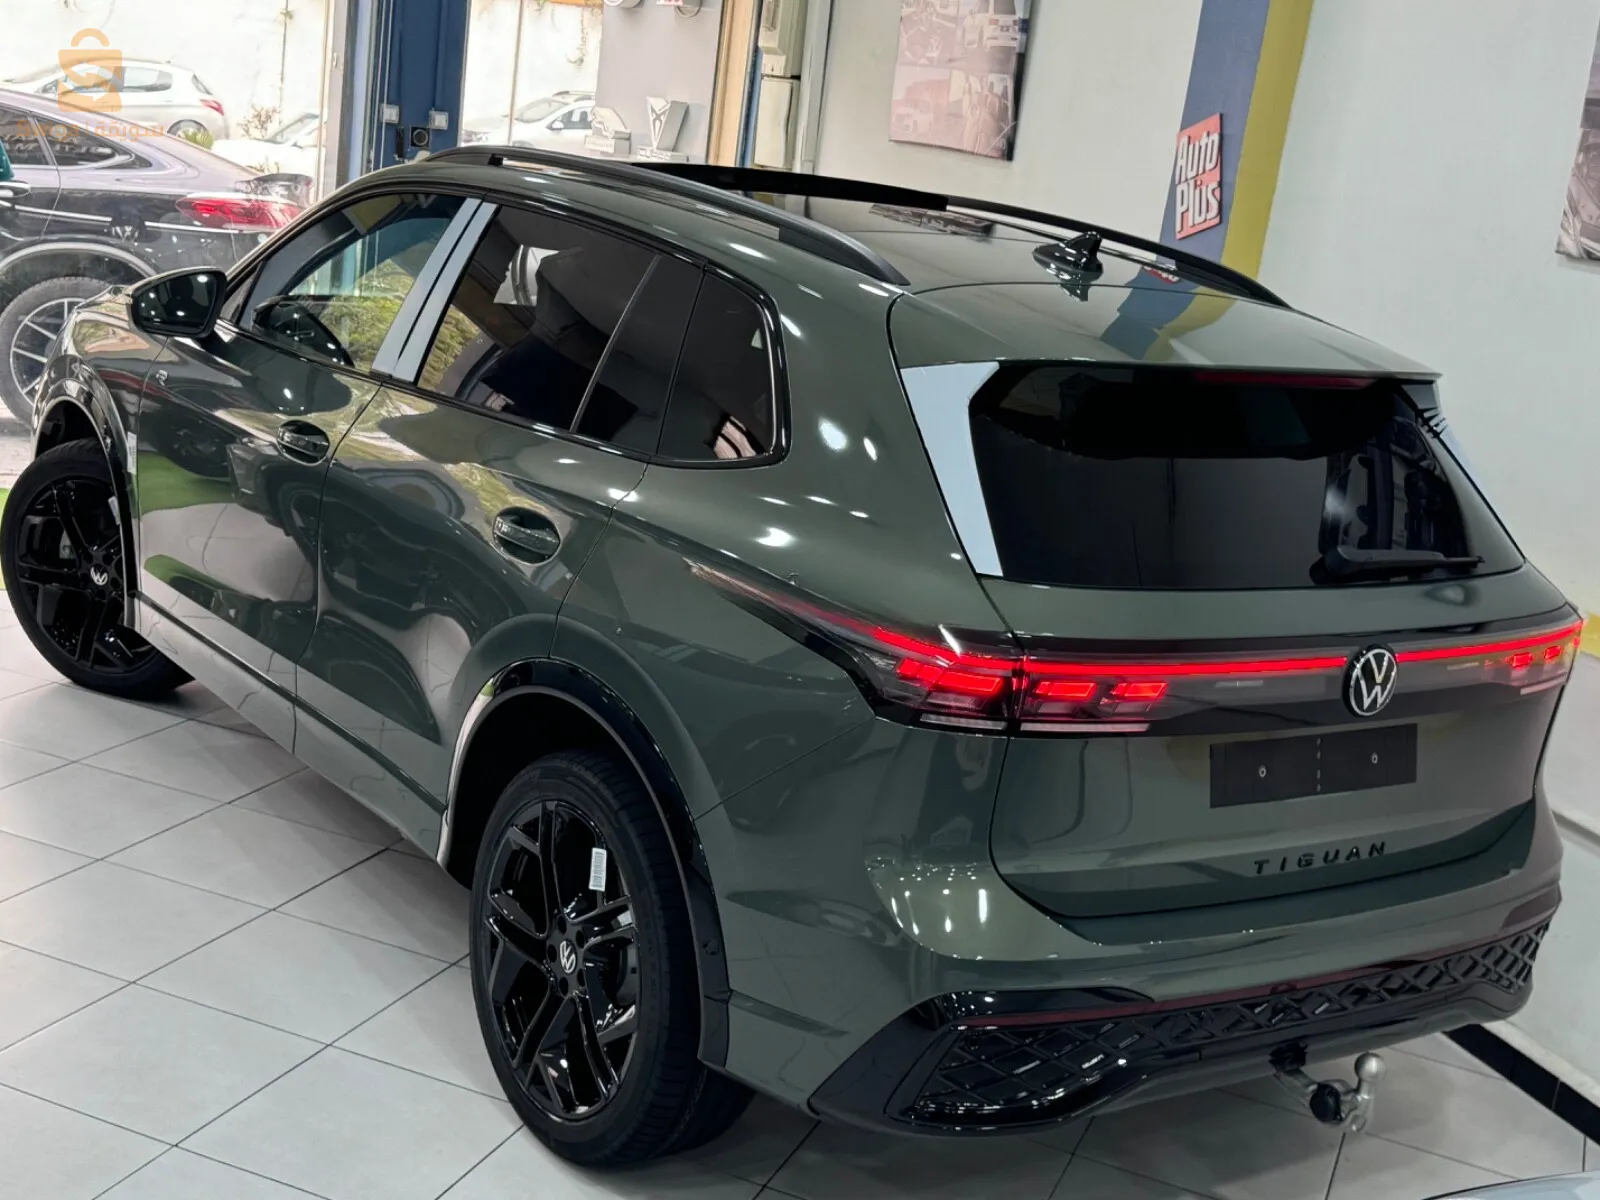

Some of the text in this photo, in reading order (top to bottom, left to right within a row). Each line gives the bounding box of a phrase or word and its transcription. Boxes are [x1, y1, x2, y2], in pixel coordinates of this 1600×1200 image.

[1175, 130, 1220, 185] Auto
[1175, 181, 1220, 234] Plus
[1253, 841, 1386, 875] TIGUAN
